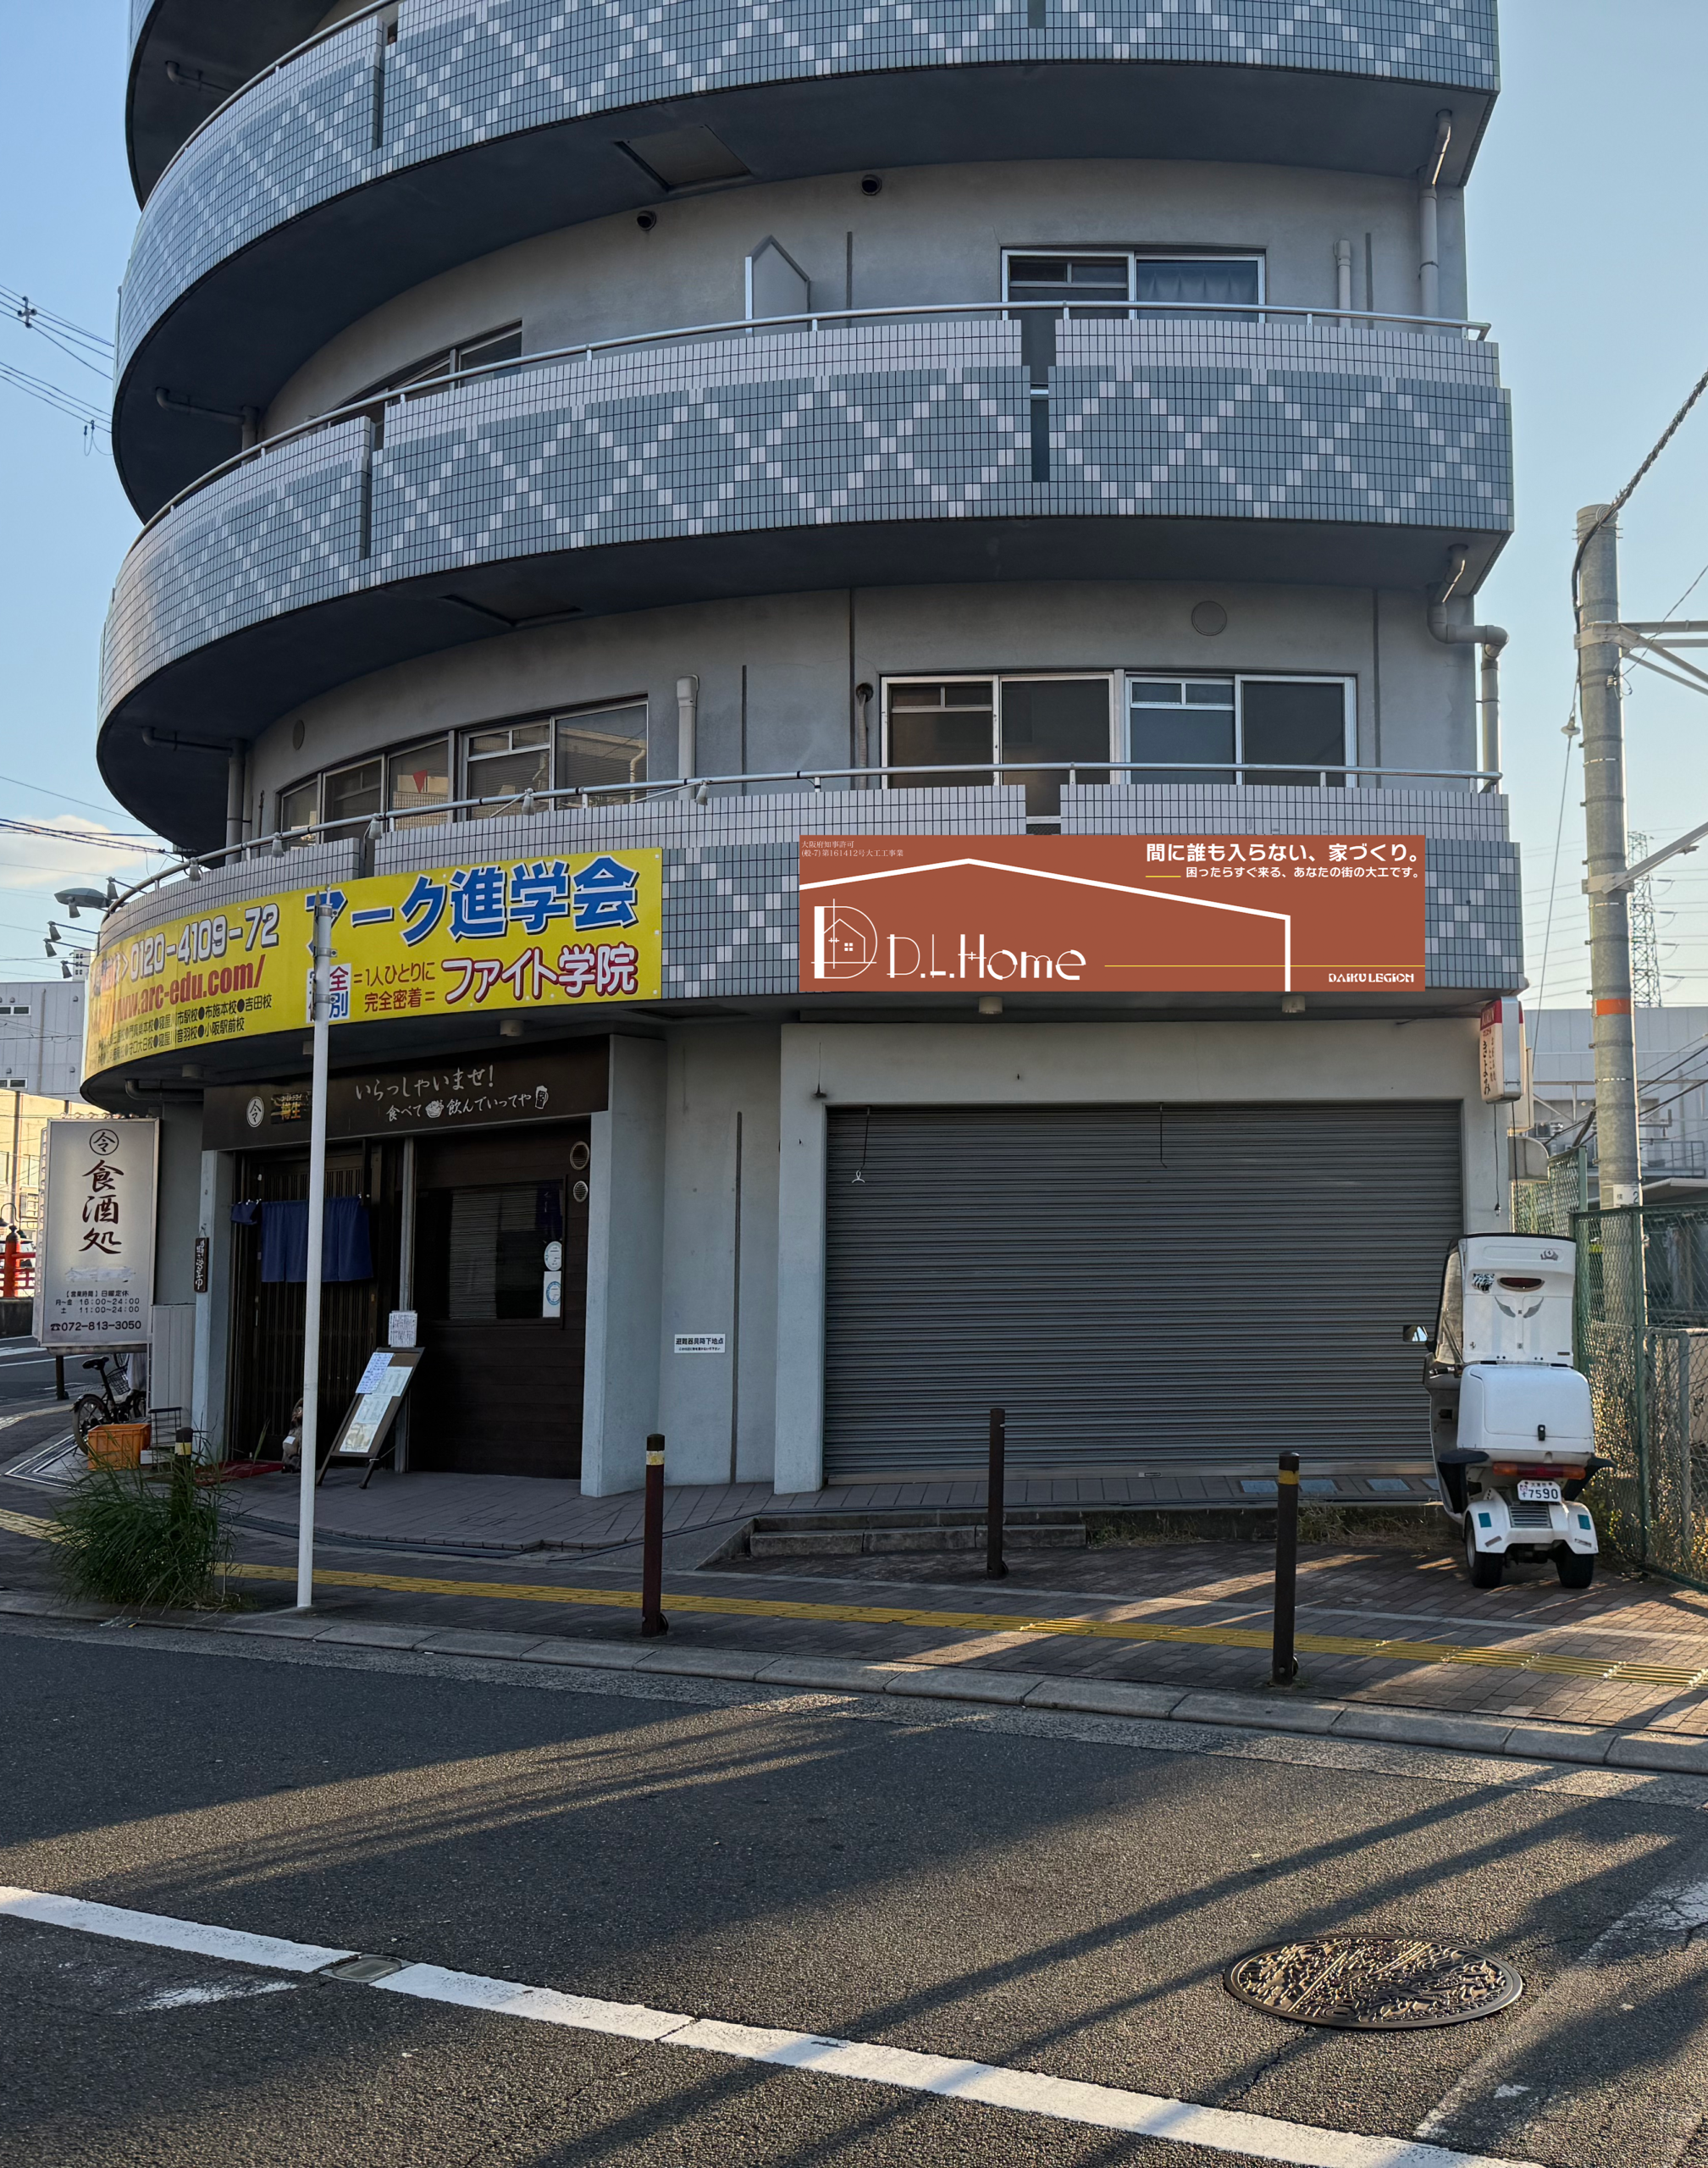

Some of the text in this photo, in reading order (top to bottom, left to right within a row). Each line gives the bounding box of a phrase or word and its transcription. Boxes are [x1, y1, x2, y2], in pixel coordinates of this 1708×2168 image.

[1146, 843, 1418, 862] 間に誰も入らない、家づくり。
[1186, 866, 1418, 879] 困ったらすぐ来る、あなたの街の大工です。
[305, 854, 639, 957] アーク進学会
[441, 941, 638, 1005] ファイト学院
[1329, 973, 1414, 982] DAIKU LEGION
[78, 1159, 124, 1254] 食酒処
[61, 1320, 142, 1331] 072-813-3050
[1528, 1488, 1559, 1500] 7590
